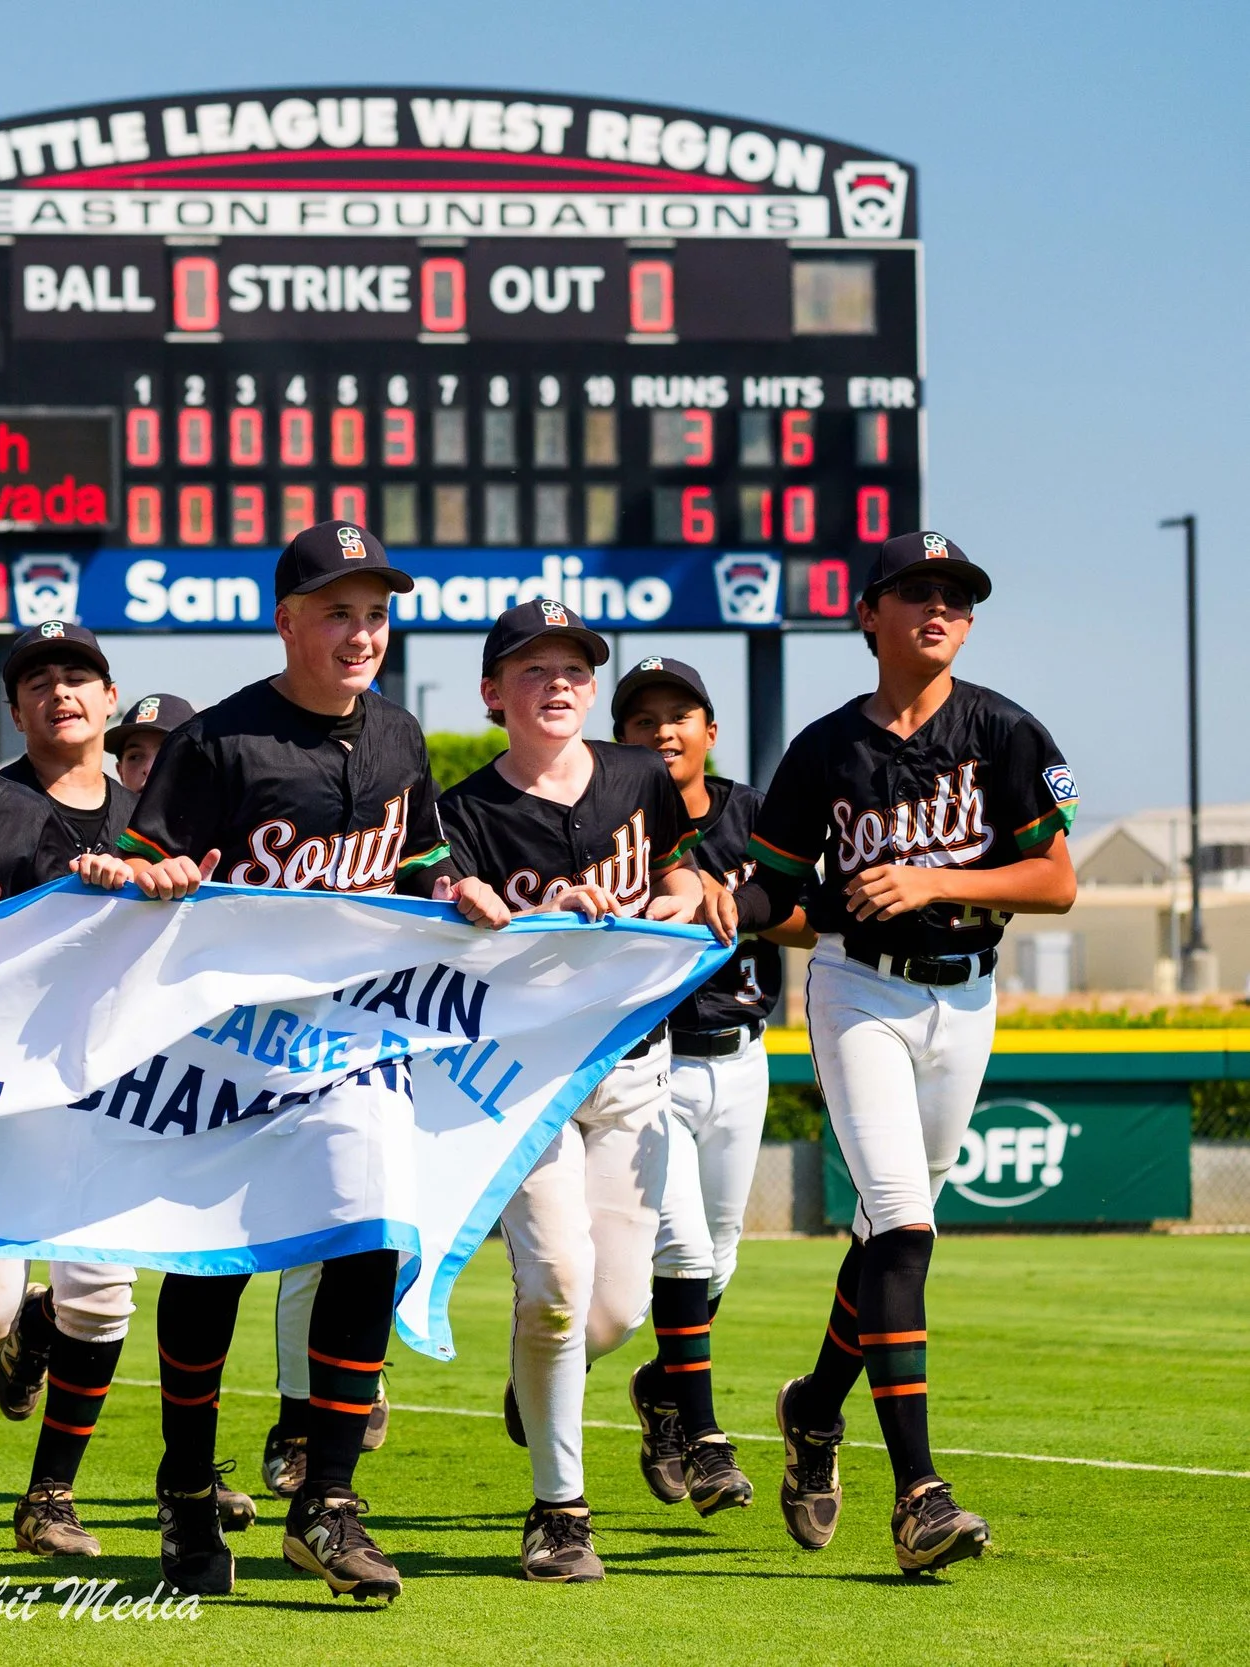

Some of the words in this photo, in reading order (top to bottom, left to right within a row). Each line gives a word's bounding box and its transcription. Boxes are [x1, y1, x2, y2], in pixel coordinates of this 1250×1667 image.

[162, 97, 399, 157] LEAGUE
[410, 97, 573, 154] WEST
[586, 108, 826, 193] REGION
[299, 200, 800, 229] FOUNDATIONS
[24, 265, 156, 312] BALL
[173, 256, 219, 331] 0
[228, 265, 412, 313] STRIKE
[421, 257, 467, 332] 0
[489, 265, 605, 313] OUT
[630, 259, 675, 333] 0
[134, 376, 150, 405] 1
[184, 376, 206, 405] 2
[236, 376, 256, 405] 3
[285, 376, 307, 405] 4
[337, 376, 358, 405] 5
[388, 376, 409, 406] 6
[438, 376, 458, 406] 7
[489, 376, 510, 406] 8
[540, 376, 560, 406] 9
[584, 376, 616, 407] 10
[631, 376, 728, 408] RUNS
[744, 377, 824, 408] HITS
[848, 378, 915, 409] ERR
[127, 408, 160, 466] 0
[178, 408, 212, 466] 0
[230, 408, 264, 466] 0
[281, 408, 314, 466] 0
[332, 408, 366, 466] 0
[382, 408, 416, 466] 3
[682, 409, 714, 466] 3
[781, 409, 814, 466] 6
[876, 412, 888, 464] 1
[127, 485, 162, 545] 0
[178, 485, 213, 545] 0
[232, 485, 265, 544] 3
[282, 485, 315, 543] 3
[682, 486, 715, 544] 6
[761, 486, 815, 544] 10
[857, 486, 890, 544] 0
[124, 559, 261, 623] San
[388, 555, 672, 623] nardino
[832, 758, 985, 875] South
[947, 1122, 1069, 1188] OFF!
